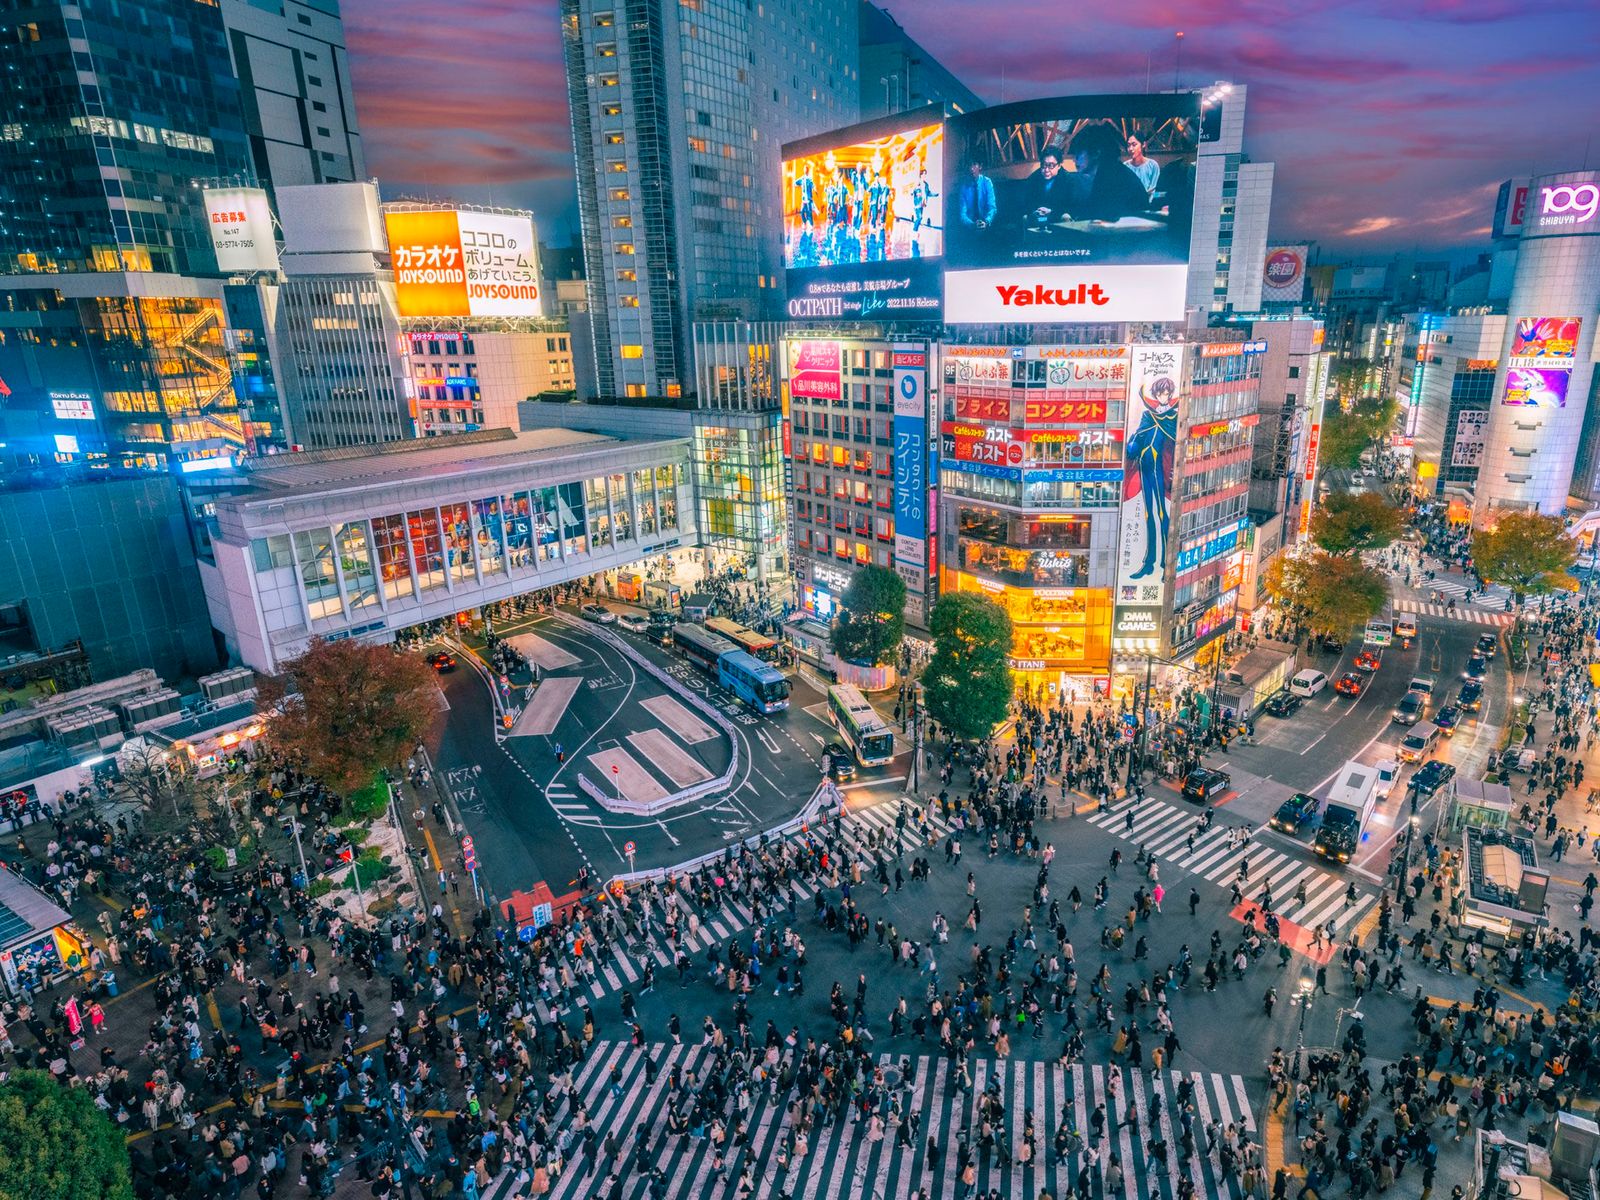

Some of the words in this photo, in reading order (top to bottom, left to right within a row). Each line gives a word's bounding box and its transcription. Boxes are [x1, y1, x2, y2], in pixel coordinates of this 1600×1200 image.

[1542, 185, 1600, 222] 109
[212, 211, 246, 223] 広告募集
[1540, 215, 1575, 225] SHIBUYA
[463, 231, 517, 249] ココロの
[396, 245, 458, 267] カラオケ
[465, 248, 533, 268] ボリューム、
[399, 269, 463, 283] JOYSOUND
[468, 268, 537, 282] あげていこう。
[469, 284, 538, 299] JOYSOUND
[995, 284, 1110, 306] Yakult
[788, 297, 842, 317] OCTPATH
[861, 290, 886, 317] Like
[917, 297, 938, 307] Release
[1510, 358, 1535, 367] 11.18
[945, 366, 955, 375] 9F
[975, 363, 1008, 380] しゃぶ葉
[1074, 363, 1125, 380] しゃぶ葉
[798, 381, 837, 393] 品川美容外科
[897, 403, 921, 412] eyecity
[957, 400, 1009, 416] プライス
[1027, 403, 1103, 418] コンタクト
[986, 428, 1012, 442] ガスト
[1079, 431, 1115, 445] ガスト
[944, 441, 955, 451] 7F
[973, 443, 1004, 461] ガスト
[898, 432, 910, 517] アイシティ
[962, 462, 1007, 476] 英会話イーオン
[1055, 471, 1121, 480] 英会話イーオン
[912, 434, 920, 519] コンタクトの
[421, 516, 449, 528] nothng
[1177, 549, 1198, 567] AGA
[1124, 612, 1152, 621] DMM
[1118, 621, 1157, 631] GAMES
